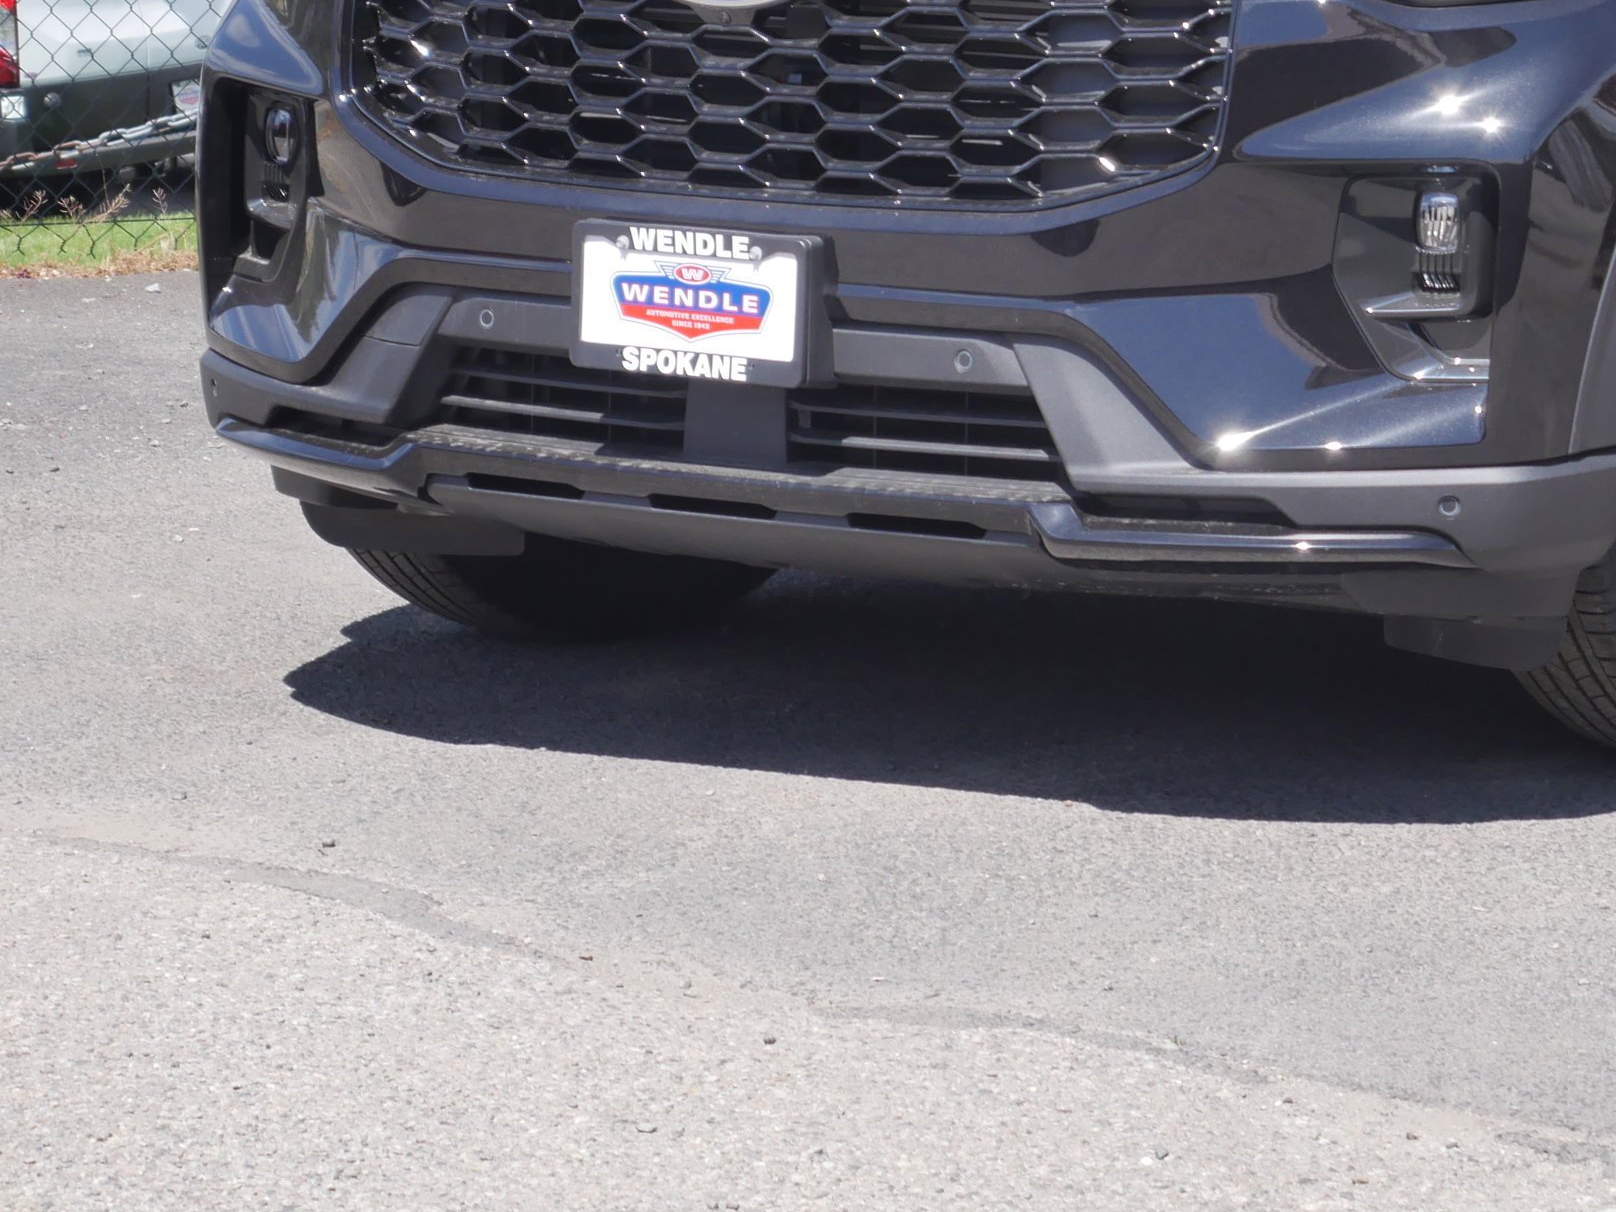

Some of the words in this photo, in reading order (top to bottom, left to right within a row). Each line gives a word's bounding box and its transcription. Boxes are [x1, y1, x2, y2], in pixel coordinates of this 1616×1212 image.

[629, 226, 750, 260] WENDLE
[621, 282, 760, 314] WENDLE
[646, 309, 690, 320] AUTOMOTIVE
[621, 346, 748, 382] SPOKANE
